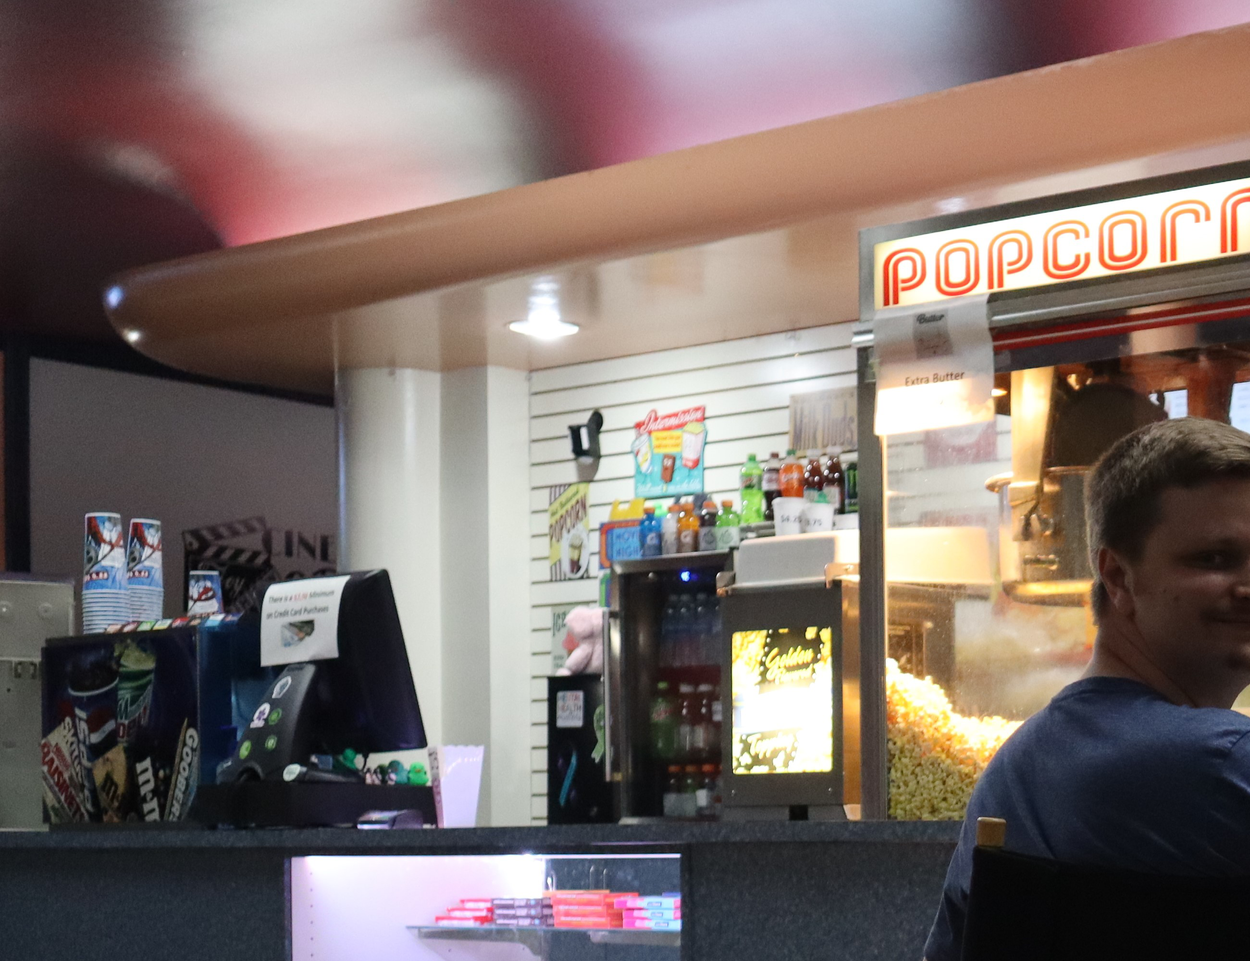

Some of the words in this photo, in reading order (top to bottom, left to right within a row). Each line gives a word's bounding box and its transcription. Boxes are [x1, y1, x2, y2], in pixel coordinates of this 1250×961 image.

[904, 376, 930, 387] Extra
[932, 371, 966, 383] Butter
[549, 494, 588, 549] POPCORN
[309, 590, 335, 598] Minimum
[273, 609, 290, 619] Credit
[290, 607, 303, 617] Card
[303, 605, 330, 615] Purchases
